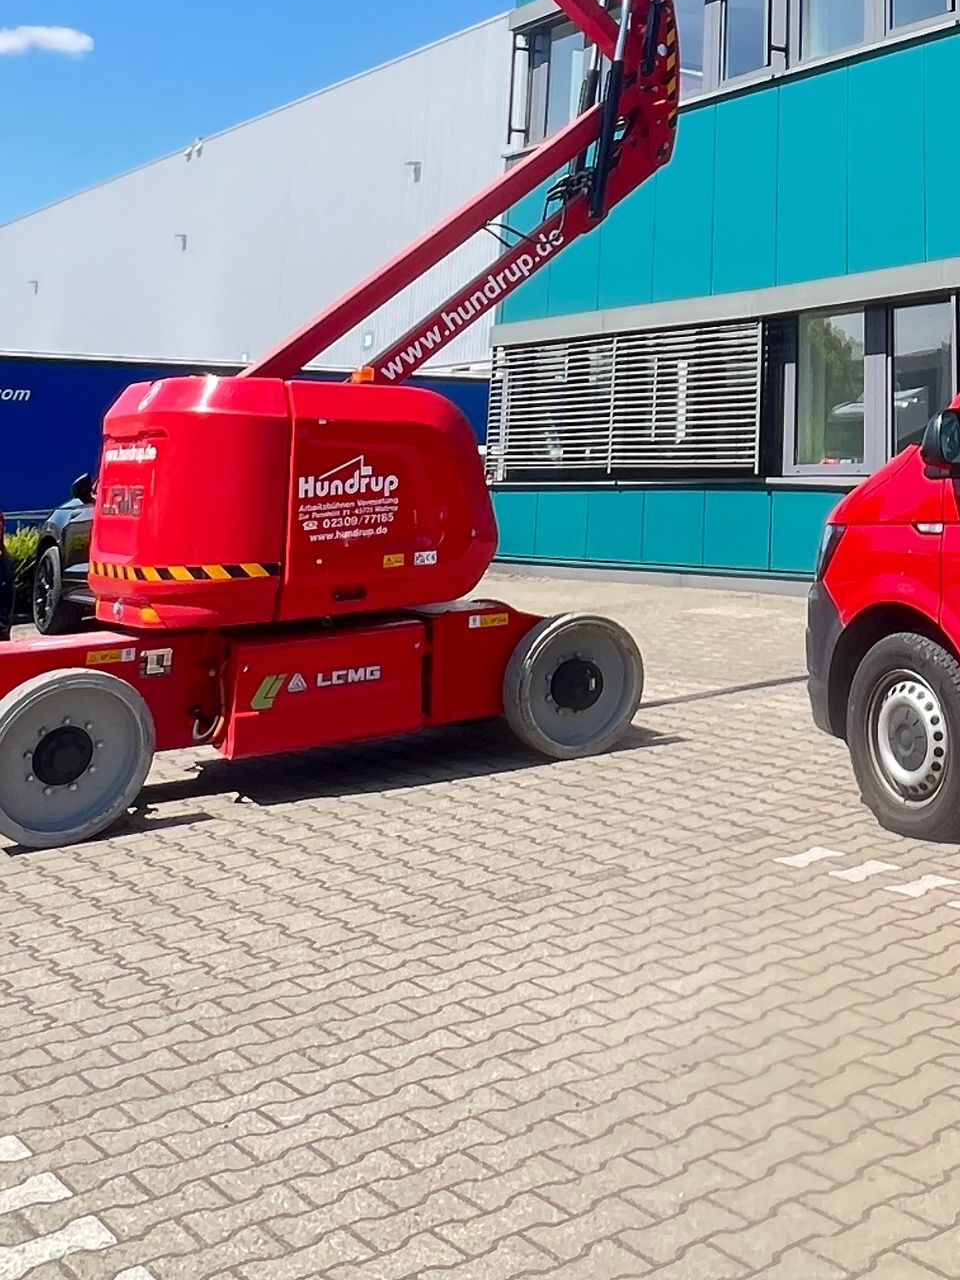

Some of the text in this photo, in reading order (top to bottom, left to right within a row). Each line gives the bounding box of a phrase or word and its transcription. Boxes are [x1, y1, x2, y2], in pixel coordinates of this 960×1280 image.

[381, 229, 564, 380] www.hundrup.de
[0, 388, 31, 401] om
[298, 468, 399, 499] Hundrup
[322, 512, 394, 529] 02309/77185
[309, 525, 389, 543] www.hundrup.de
